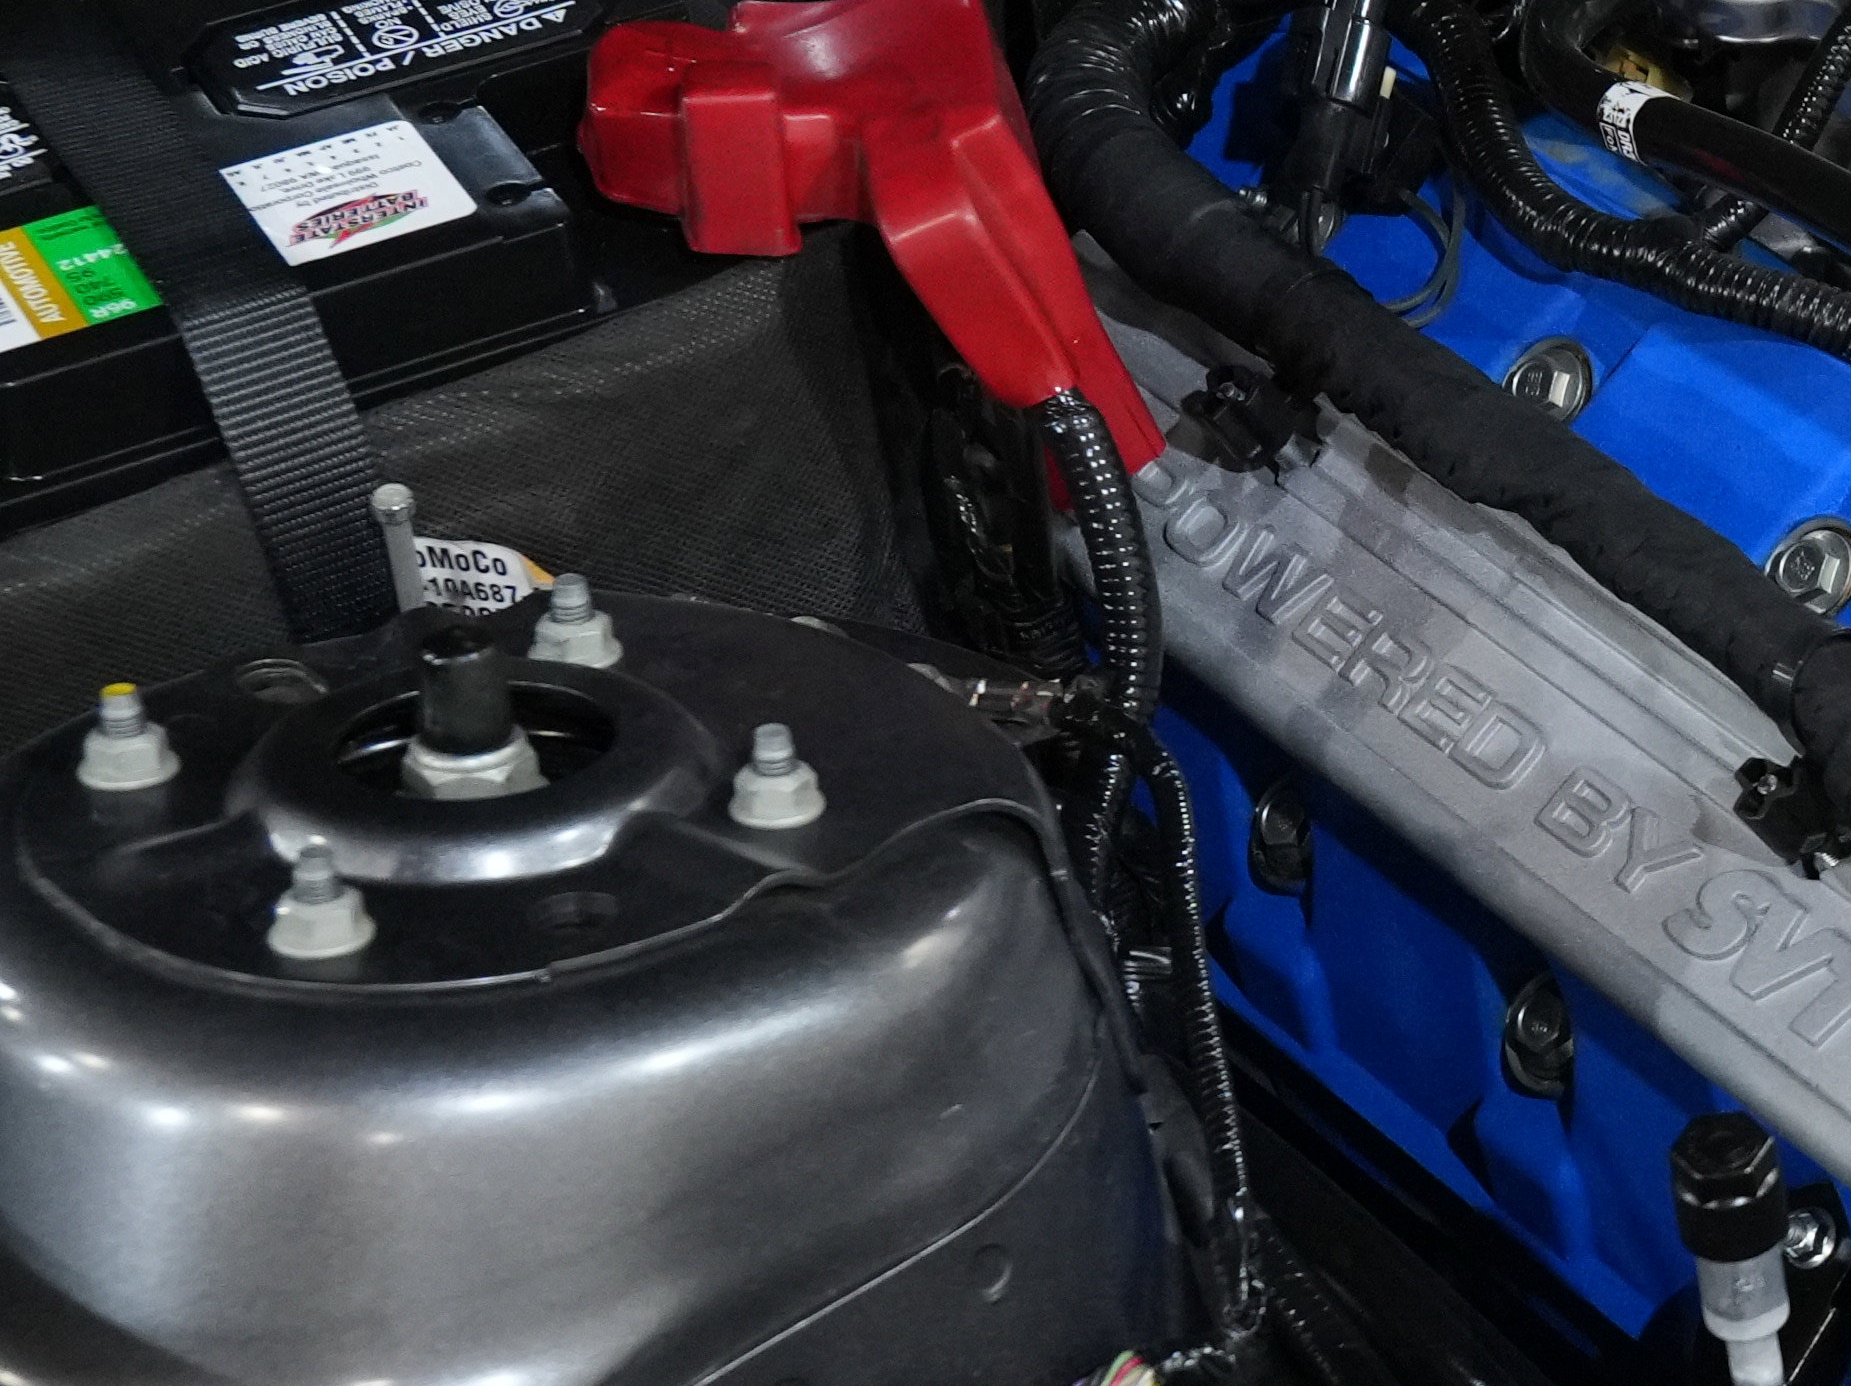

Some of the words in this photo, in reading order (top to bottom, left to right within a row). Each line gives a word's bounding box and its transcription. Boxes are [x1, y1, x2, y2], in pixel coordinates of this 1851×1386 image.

[440, 9, 493, 33] SHIELD
[446, 3, 487, 19] EYES
[375, 17, 402, 30] NO
[269, 31, 343, 58] SULFURIC
[421, 20, 543, 58] DANGER
[233, 53, 269, 68] ACID
[284, 57, 396, 95] POISON
[379, 160, 422, 175] Costco
[315, 173, 378, 193] Wholesale
[251, 191, 314, 212] Corporatio
[295, 191, 414, 233] BATTERIES
[293, 199, 426, 244] INTERSTATE
[89, 299, 137, 318] 96R
[415, 546, 508, 576] oMoCo
[1532, 766, 1704, 897] BY
